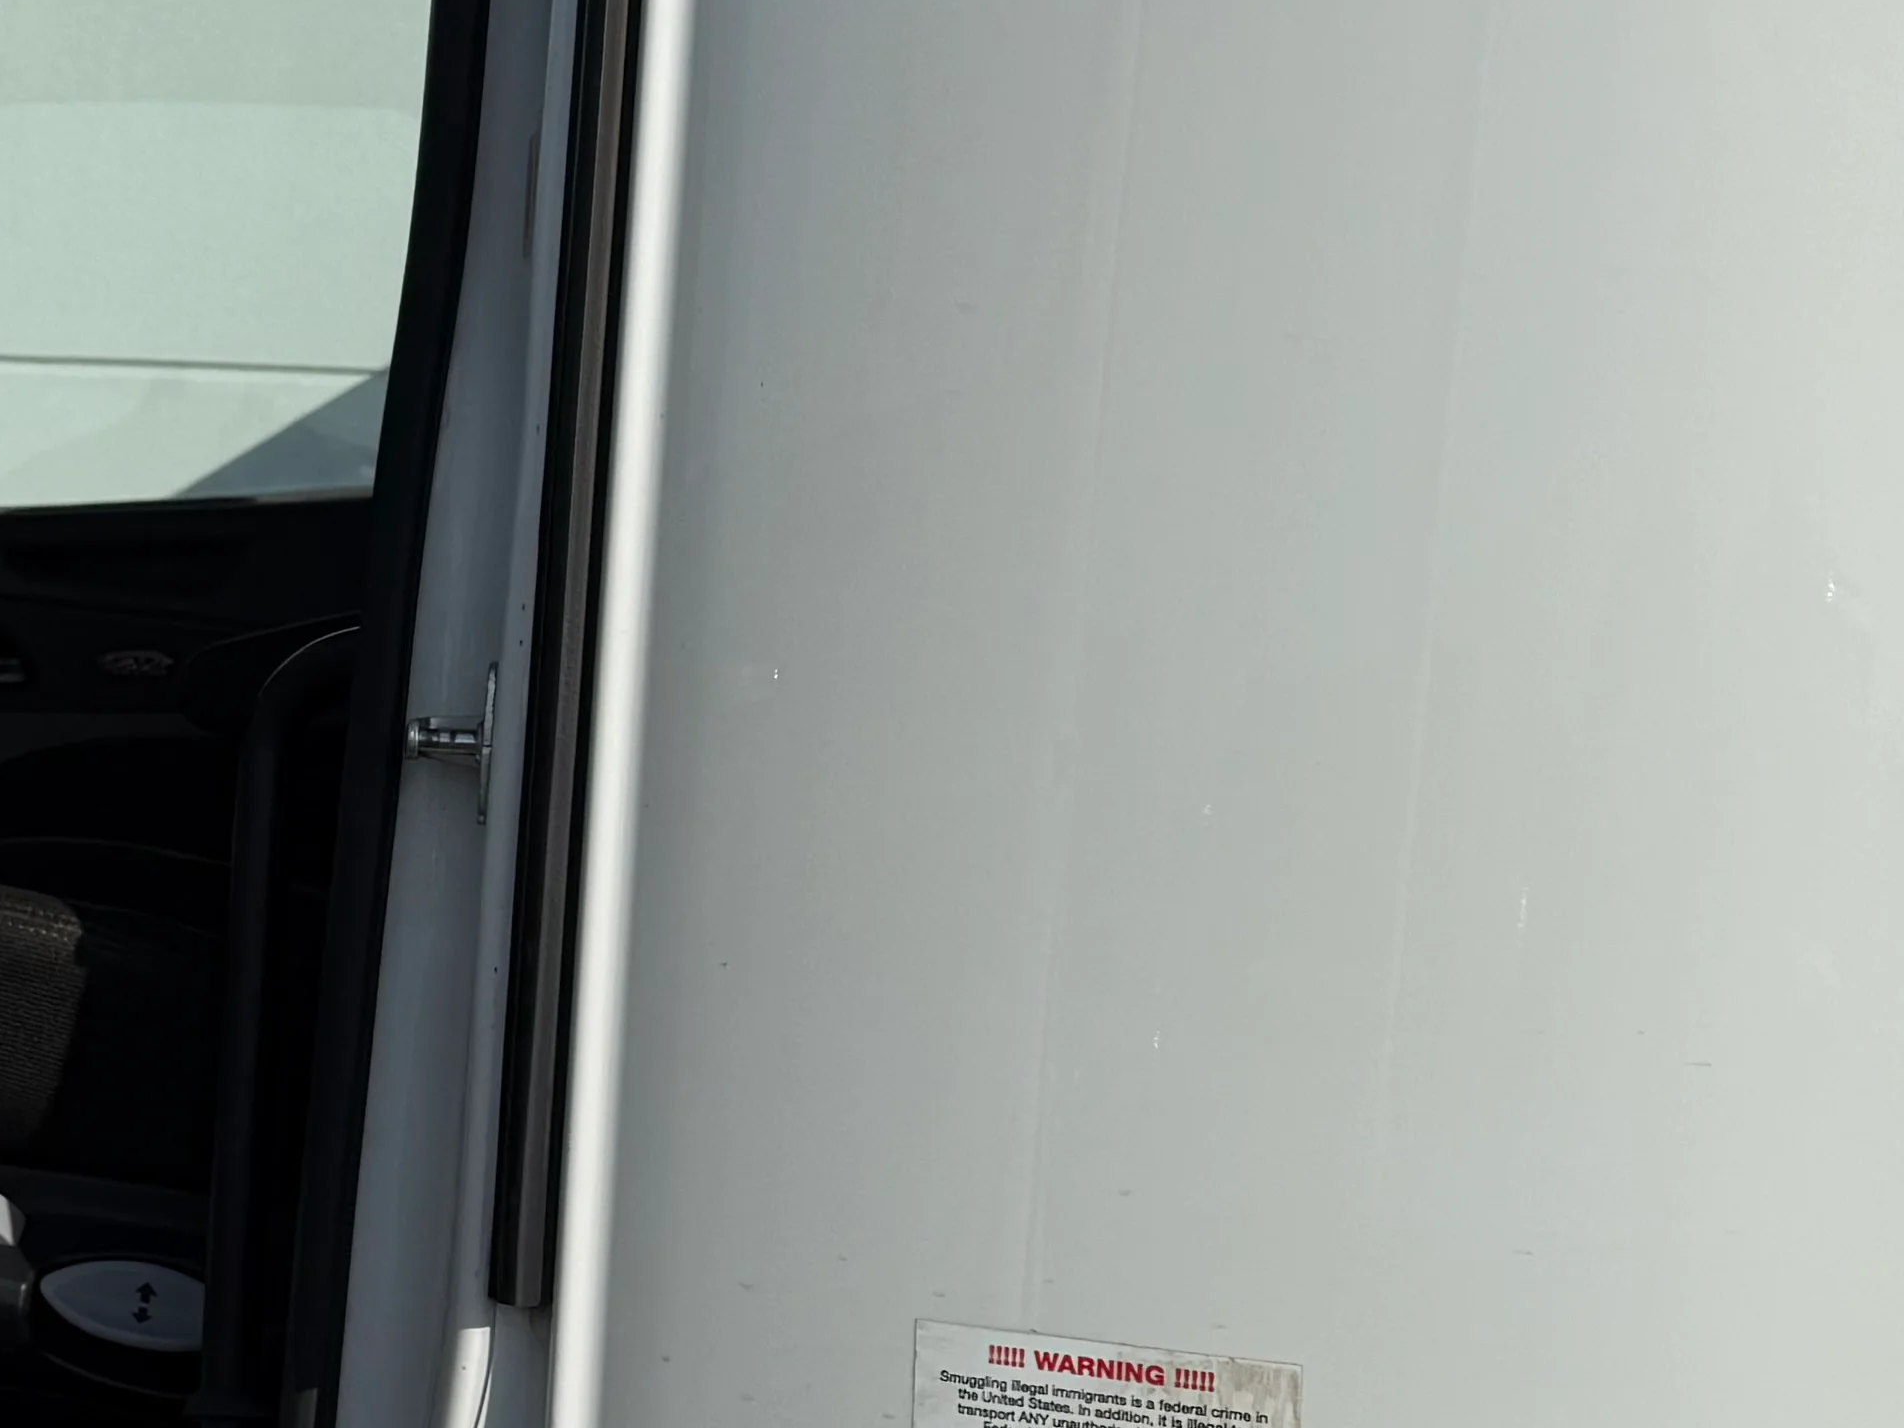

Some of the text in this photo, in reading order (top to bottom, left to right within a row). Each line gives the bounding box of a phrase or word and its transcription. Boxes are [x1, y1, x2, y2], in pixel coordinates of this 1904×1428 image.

[1033, 1349, 1165, 1386] WARNING
[939, 1369, 1268, 1424] Smuggling illegal immigrants is a federal crime in
[957, 1387, 979, 1402] the
[980, 1390, 1025, 1408] United
[1027, 1396, 1075, 1415] States.
[1077, 1403, 1091, 1417] In
[1093, 1407, 1154, 1427] addition,
[1157, 1413, 1167, 1428] it
[1170, 1415, 1183, 1428] is
[957, 1402, 1016, 1422] transport
[1017, 1410, 1050, 1426] ANY
